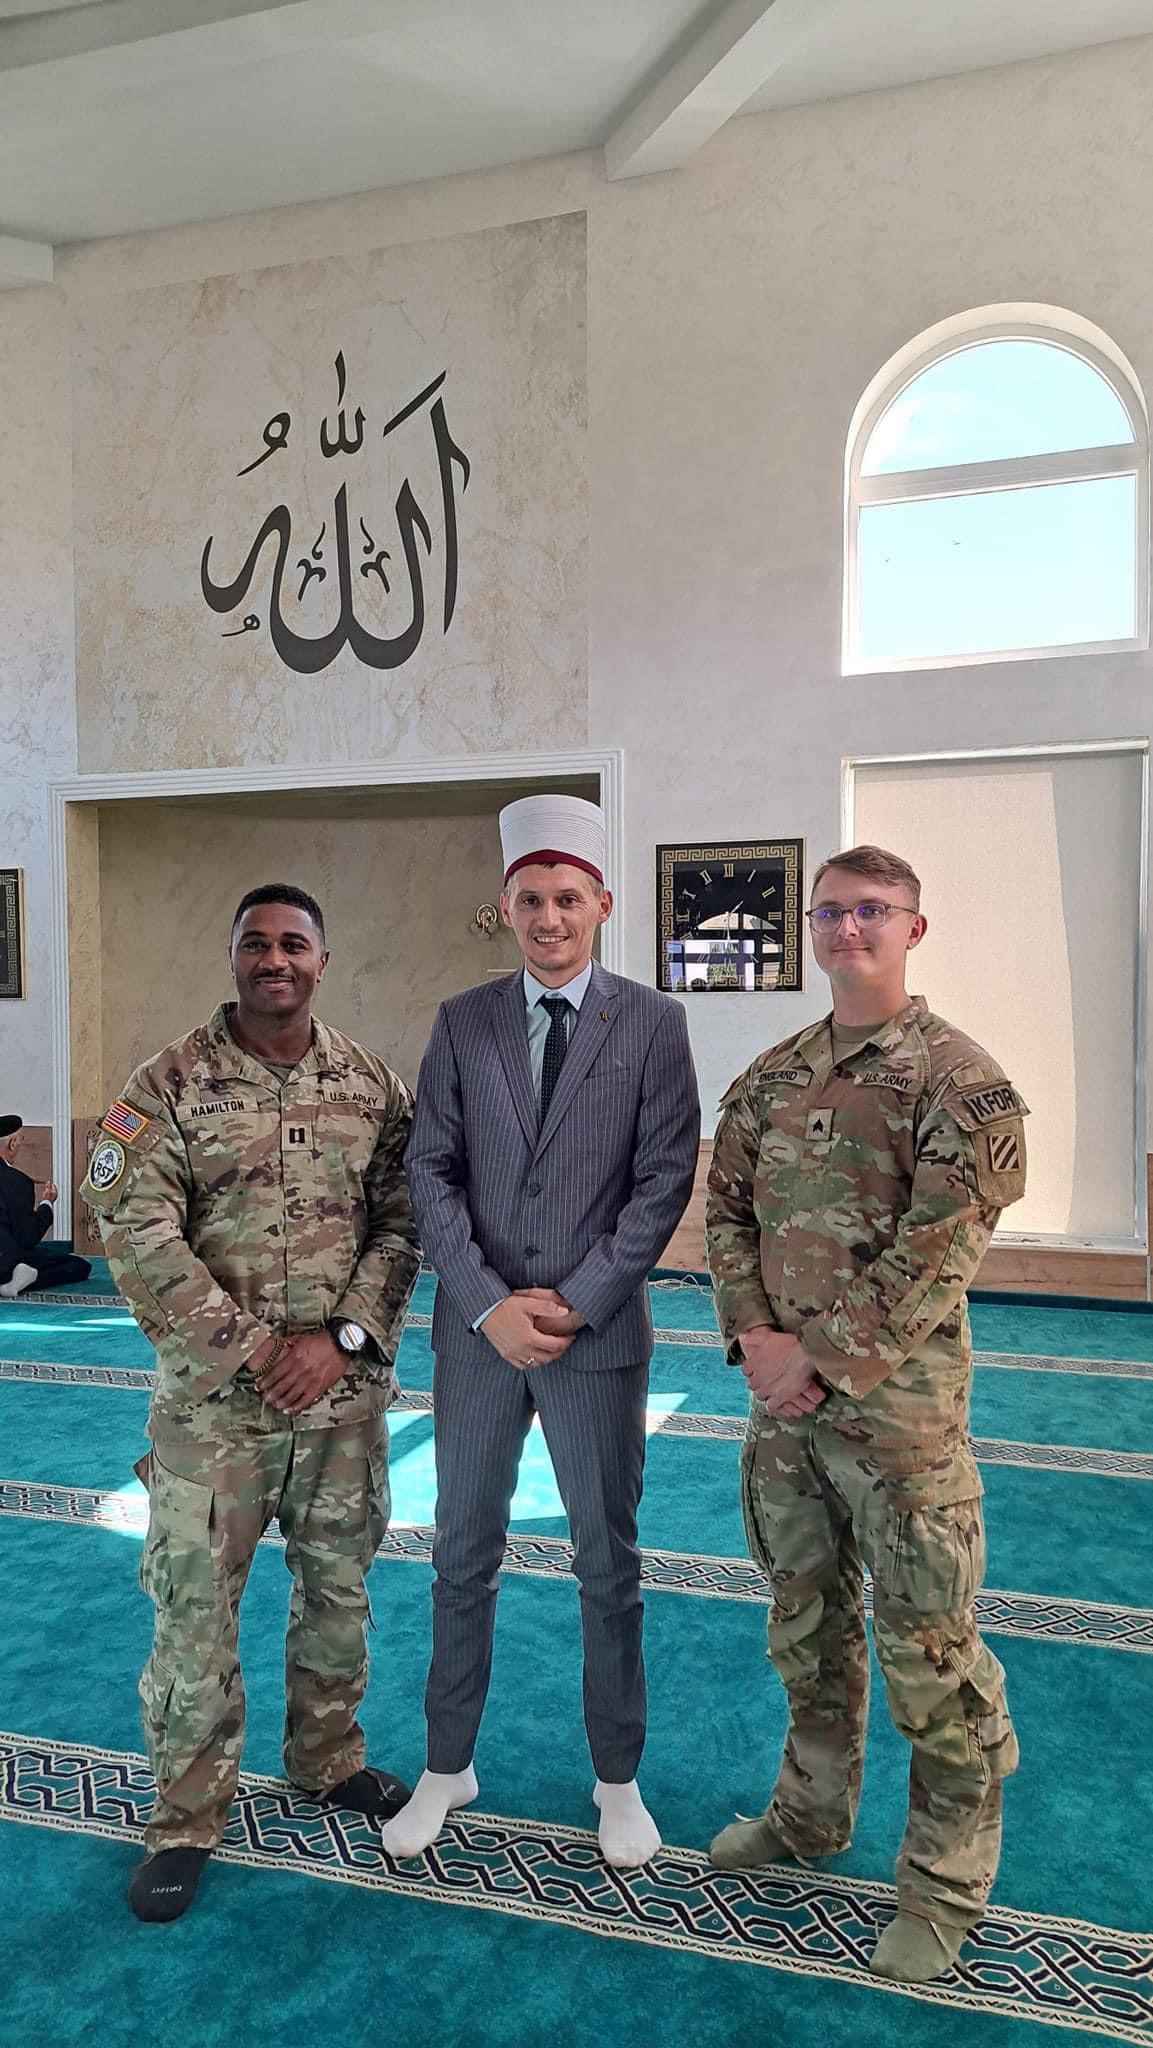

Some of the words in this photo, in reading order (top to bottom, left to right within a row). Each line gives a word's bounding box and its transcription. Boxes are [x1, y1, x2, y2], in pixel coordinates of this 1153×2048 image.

[880, 1074, 912, 1089] ARMY
[351, 1093, 378, 1107] ARMY
[970, 1087, 1015, 1117] KFOR
[190, 1100, 245, 1118] HAMILTON
